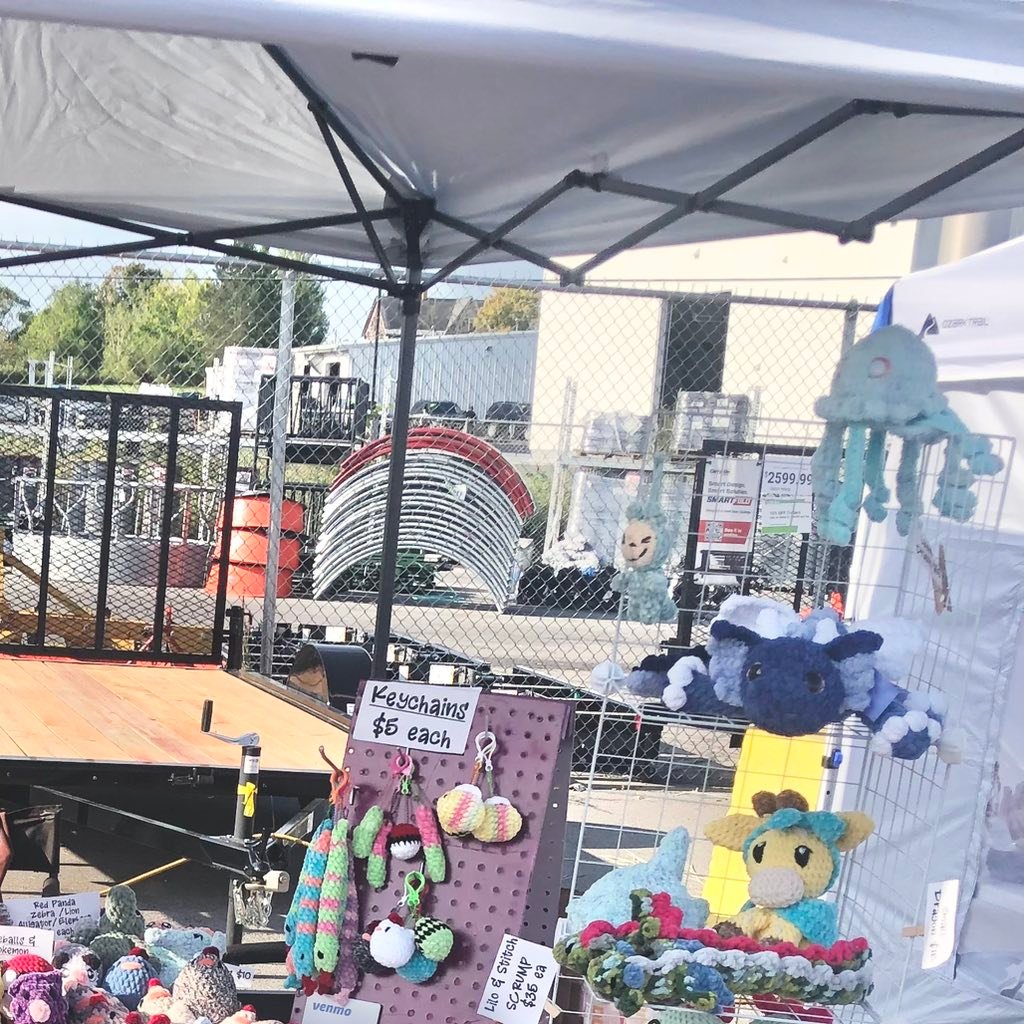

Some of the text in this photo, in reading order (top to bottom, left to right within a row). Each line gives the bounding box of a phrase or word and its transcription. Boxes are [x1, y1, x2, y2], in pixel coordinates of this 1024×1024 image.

[942, 317, 989, 328] OZARK TRAIL
[371, 685, 469, 720] Keychains
[372, 712, 451, 749] $5 each
[33, 898, 76, 909] Red Panda
[56, 927, 74, 936] each
[236, 969, 252, 980] $10
[484, 938, 518, 1012] Lilo & Stitch
[534, 965, 548, 979] ea
[506, 956, 532, 1010] SCRUMP
[312, 1002, 352, 1016] venmo
